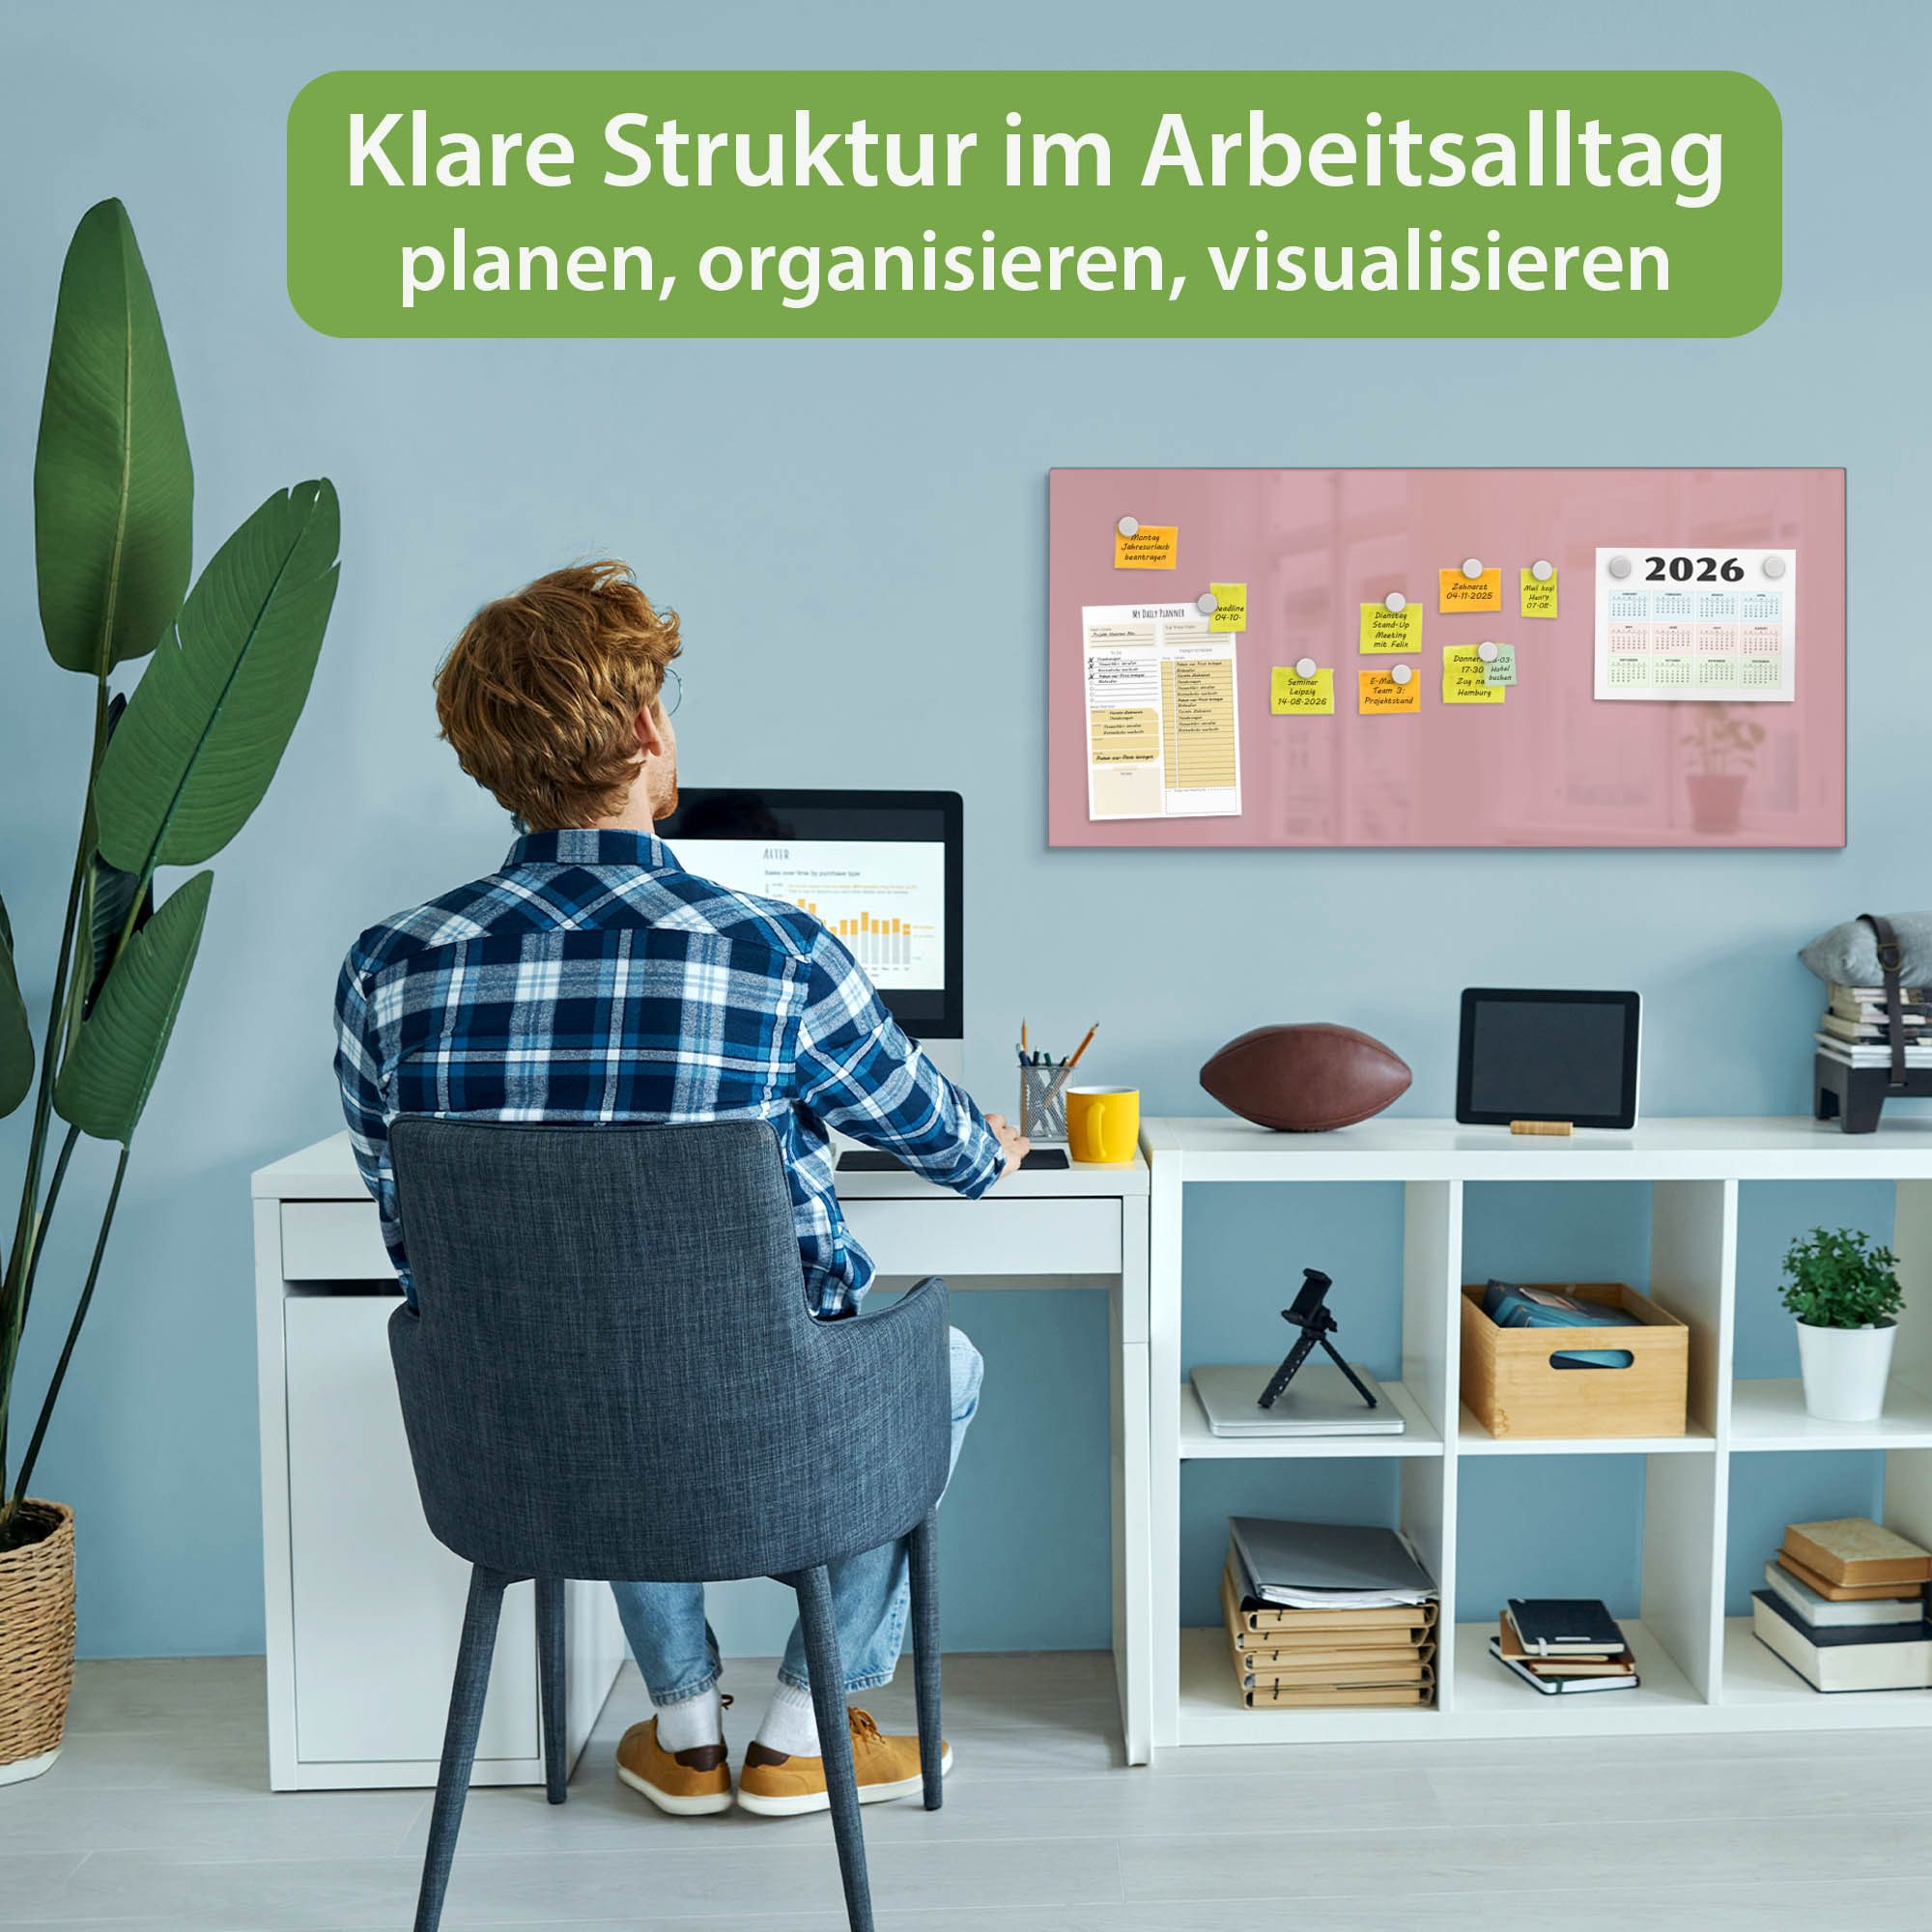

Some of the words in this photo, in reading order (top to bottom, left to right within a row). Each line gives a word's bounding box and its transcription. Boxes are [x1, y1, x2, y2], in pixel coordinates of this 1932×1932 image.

[1130, 534, 1160, 543] Montag
[1124, 554, 1167, 562] beantragen
[1645, 556, 1745, 582] 2026
[1375, 611, 1407, 620] Dienstag
[1372, 620, 1409, 629] Stand-Up
[1376, 632, 1406, 640] Meeting
[1456, 677, 1472, 686] Zug
[1289, 688, 1316, 696] Leipzig
[1457, 689, 1492, 697] Hamburg
[1364, 696, 1414, 706] Projektstand
